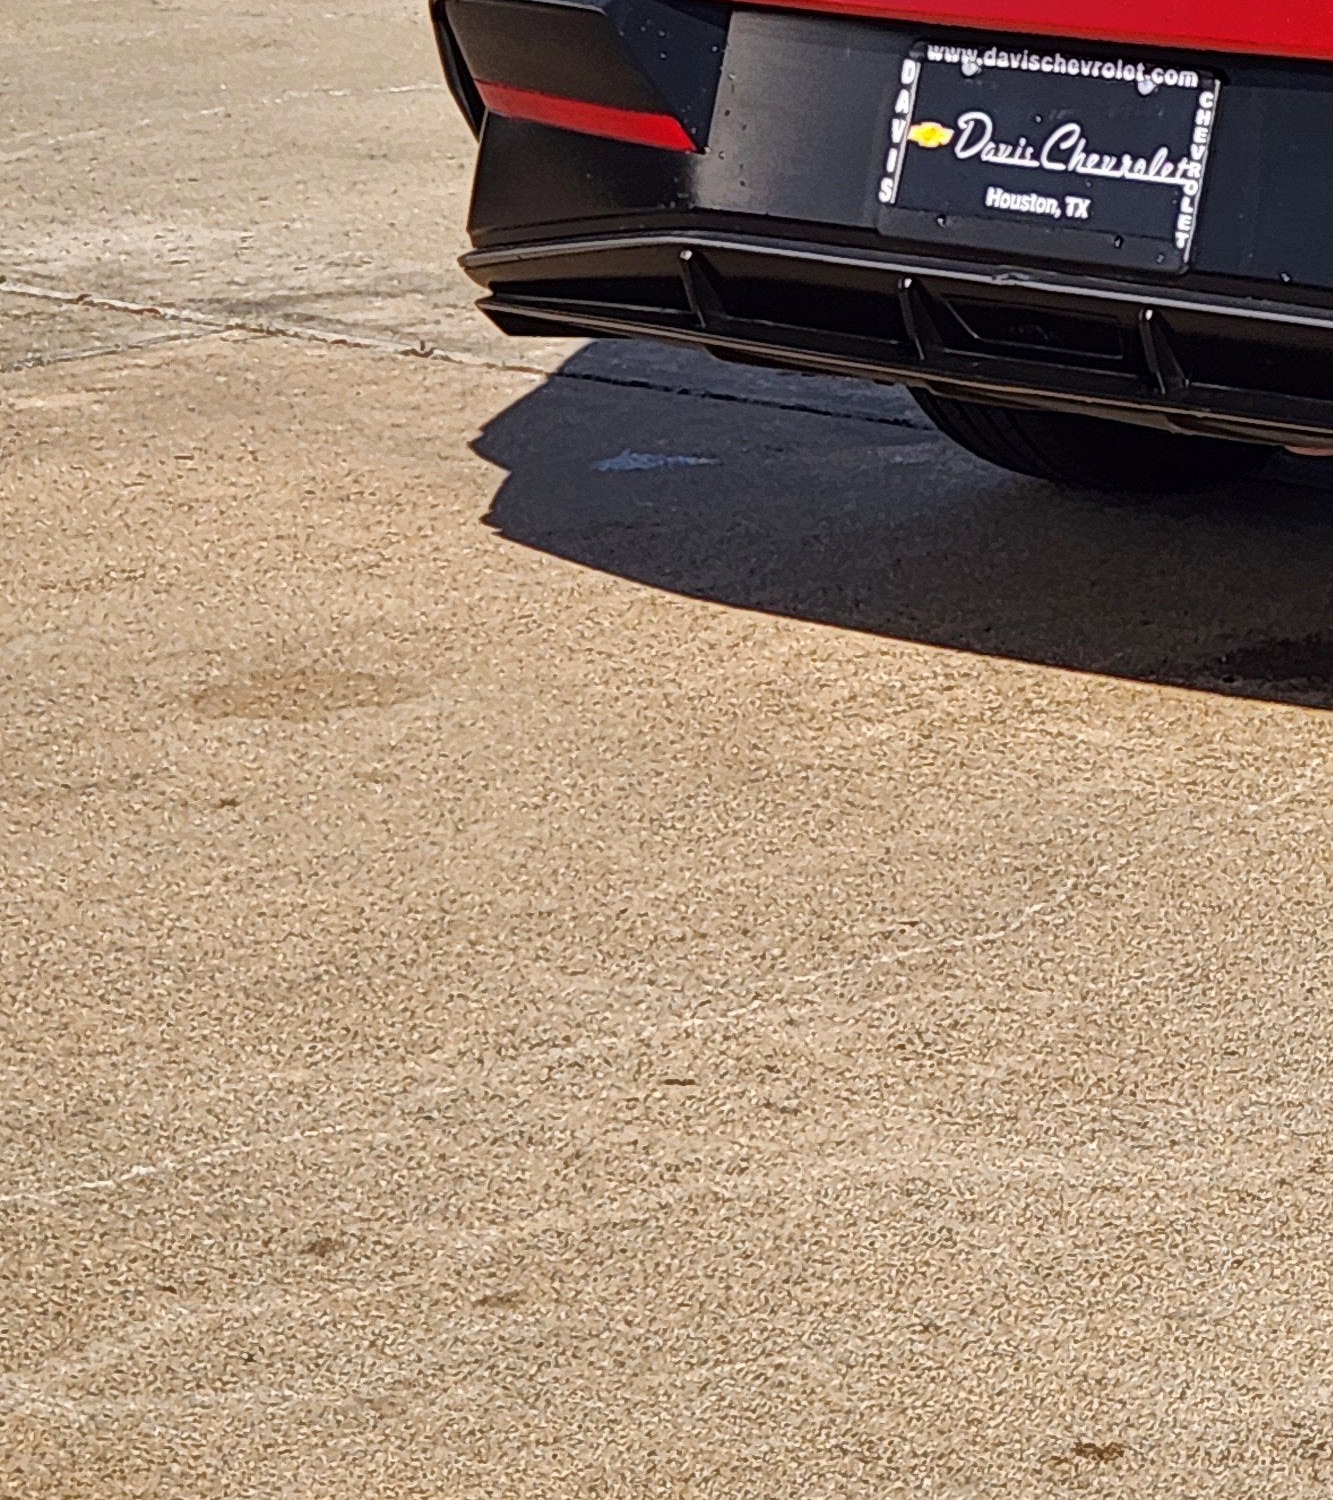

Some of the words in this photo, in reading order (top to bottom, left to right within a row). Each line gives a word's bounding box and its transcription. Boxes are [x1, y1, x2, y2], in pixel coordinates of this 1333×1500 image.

[926, 44, 1199, 88] www.davischevrolet.com
[878, 58, 916, 203] DAVIS
[954, 111, 1040, 168] Davis
[1040, 122, 1190, 186] Chevrolet
[985, 186, 1061, 219] Houston,
[1065, 195, 1092, 219] TX
[1174, 91, 1215, 249] CHEVROLET
